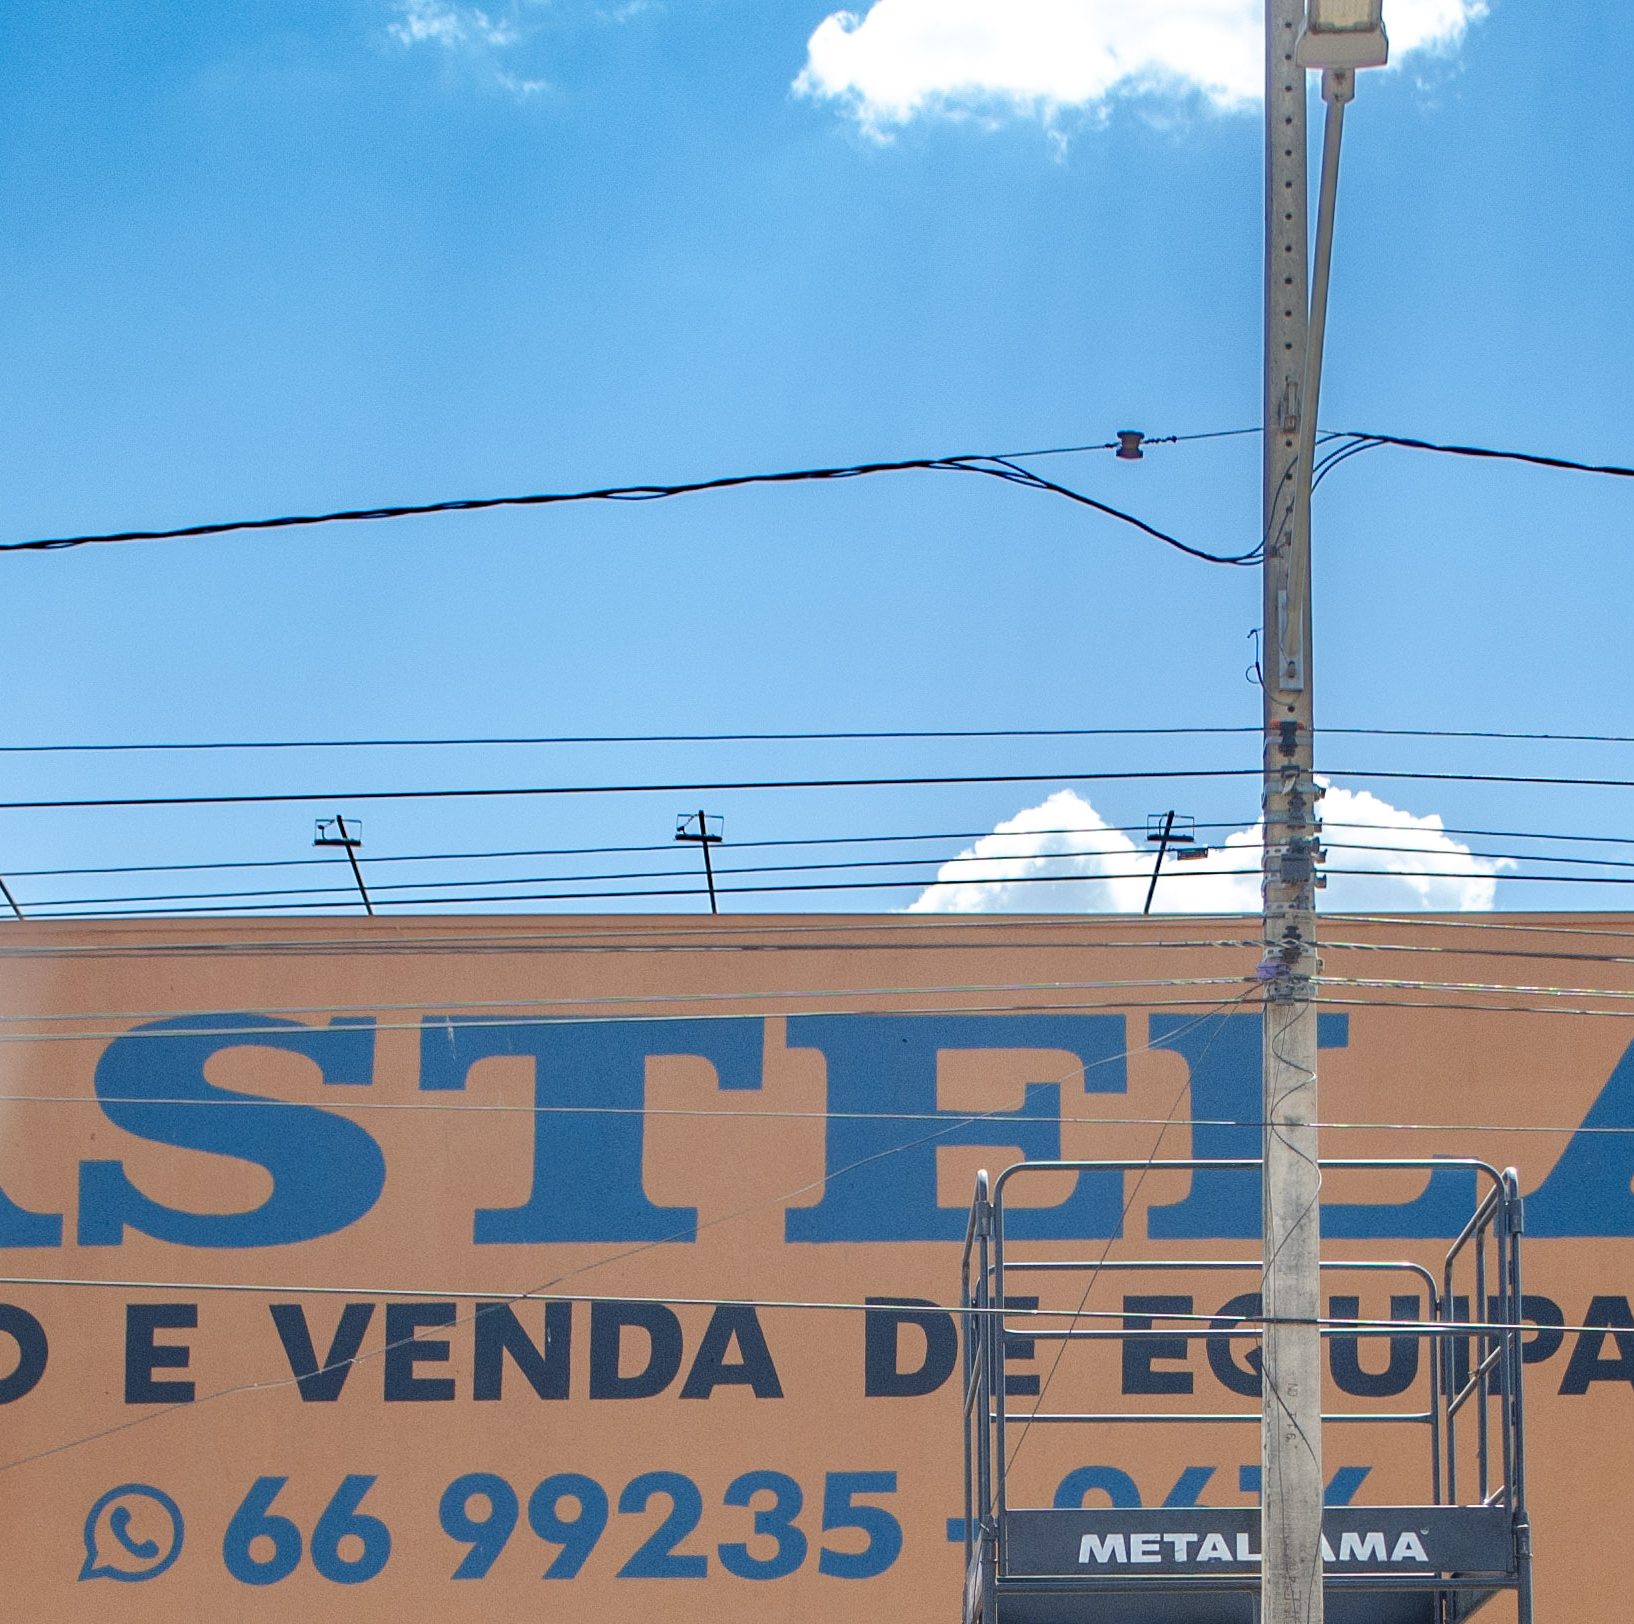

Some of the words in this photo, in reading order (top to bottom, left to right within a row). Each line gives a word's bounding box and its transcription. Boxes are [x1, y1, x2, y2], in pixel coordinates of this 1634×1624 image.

[123, 1302, 199, 1405] E
[268, 1300, 785, 1403] VENDA
[863, 1295, 1042, 1398] DE
[222, 1474, 393, 1586] 66
[437, 1468, 903, 1583] 99235
